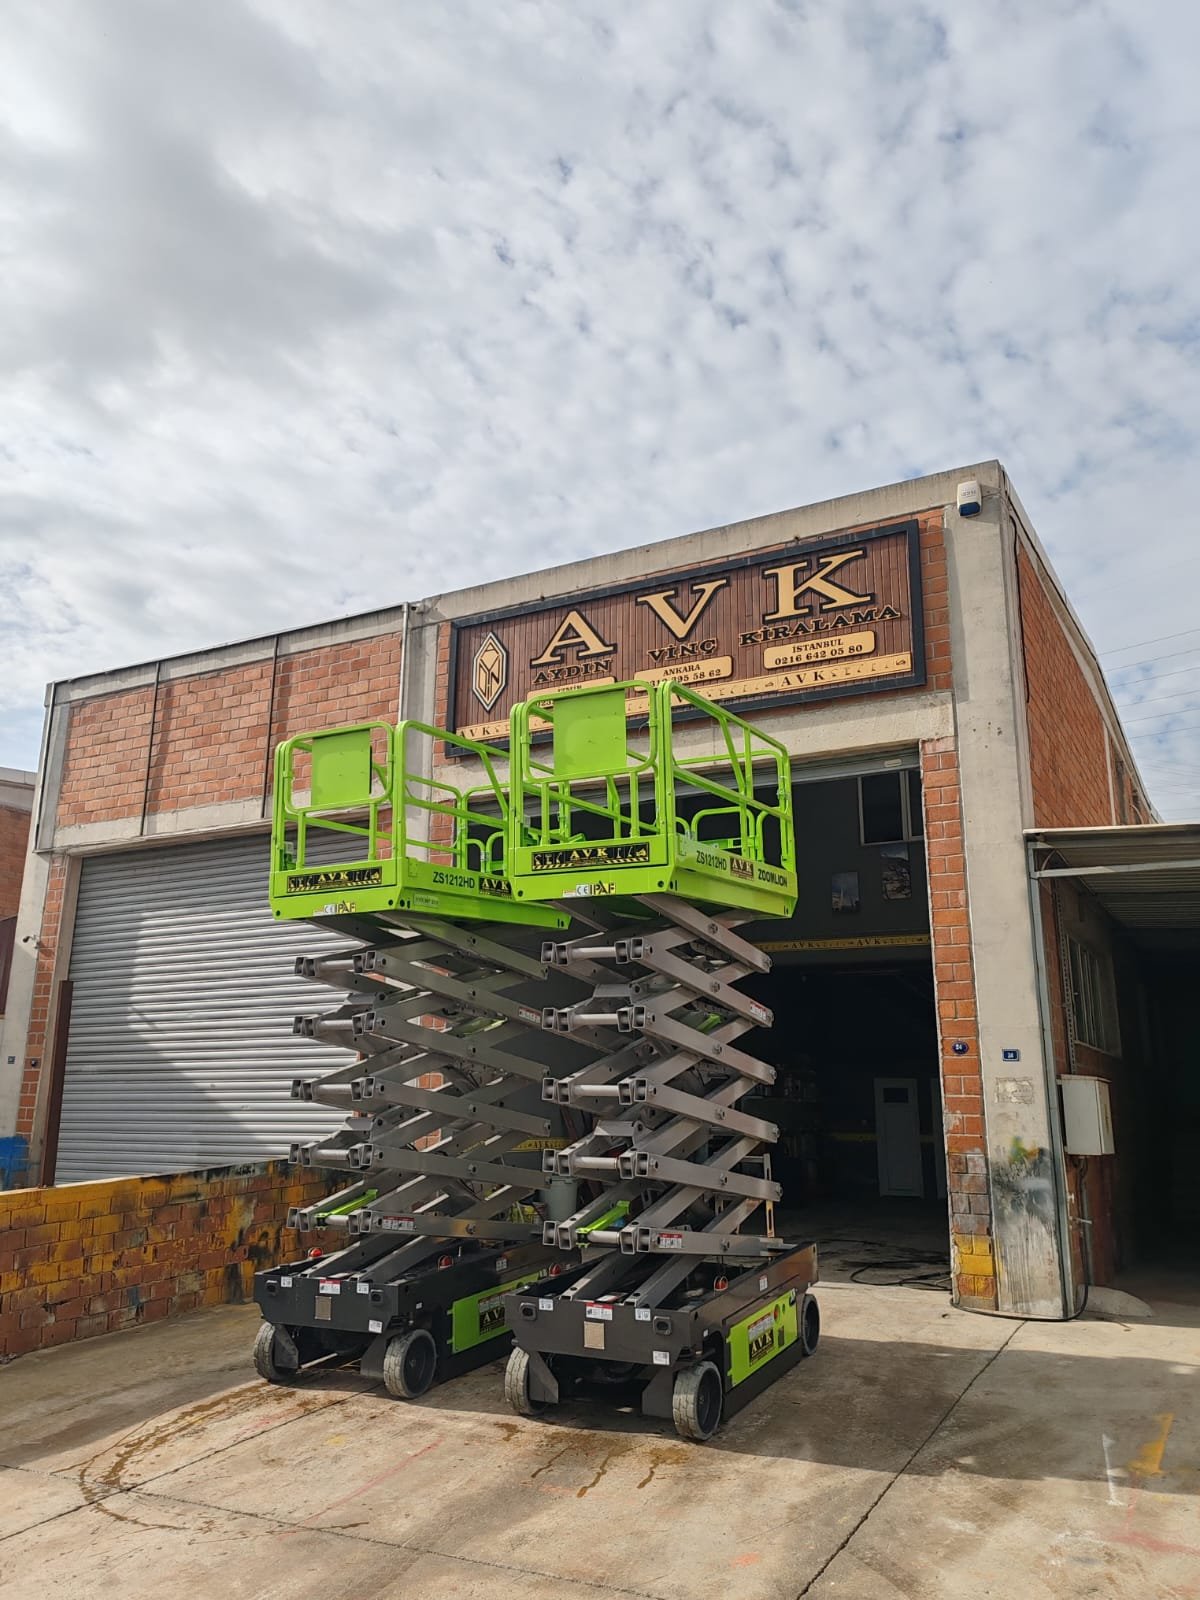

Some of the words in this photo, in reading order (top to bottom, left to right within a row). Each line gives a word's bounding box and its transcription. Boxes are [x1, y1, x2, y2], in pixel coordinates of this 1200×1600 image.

[533, 659, 613, 684] AYDIN
[648, 638, 717, 662] VİNÇ
[739, 605, 901, 647] KİRALAMA
[774, 656, 802, 666] 0216
[806, 651, 826, 661] 642
[830, 648, 844, 657] 05
[848, 644, 863, 653] 80
[663, 664, 701, 677] ANKARA
[693, 672, 705, 680] 58
[709, 669, 721, 677] 62
[696, 850, 727, 870] ZS1212HD
[758, 869, 788, 888] ZOOMLION
[432, 871, 476, 889] ZS1212HD
